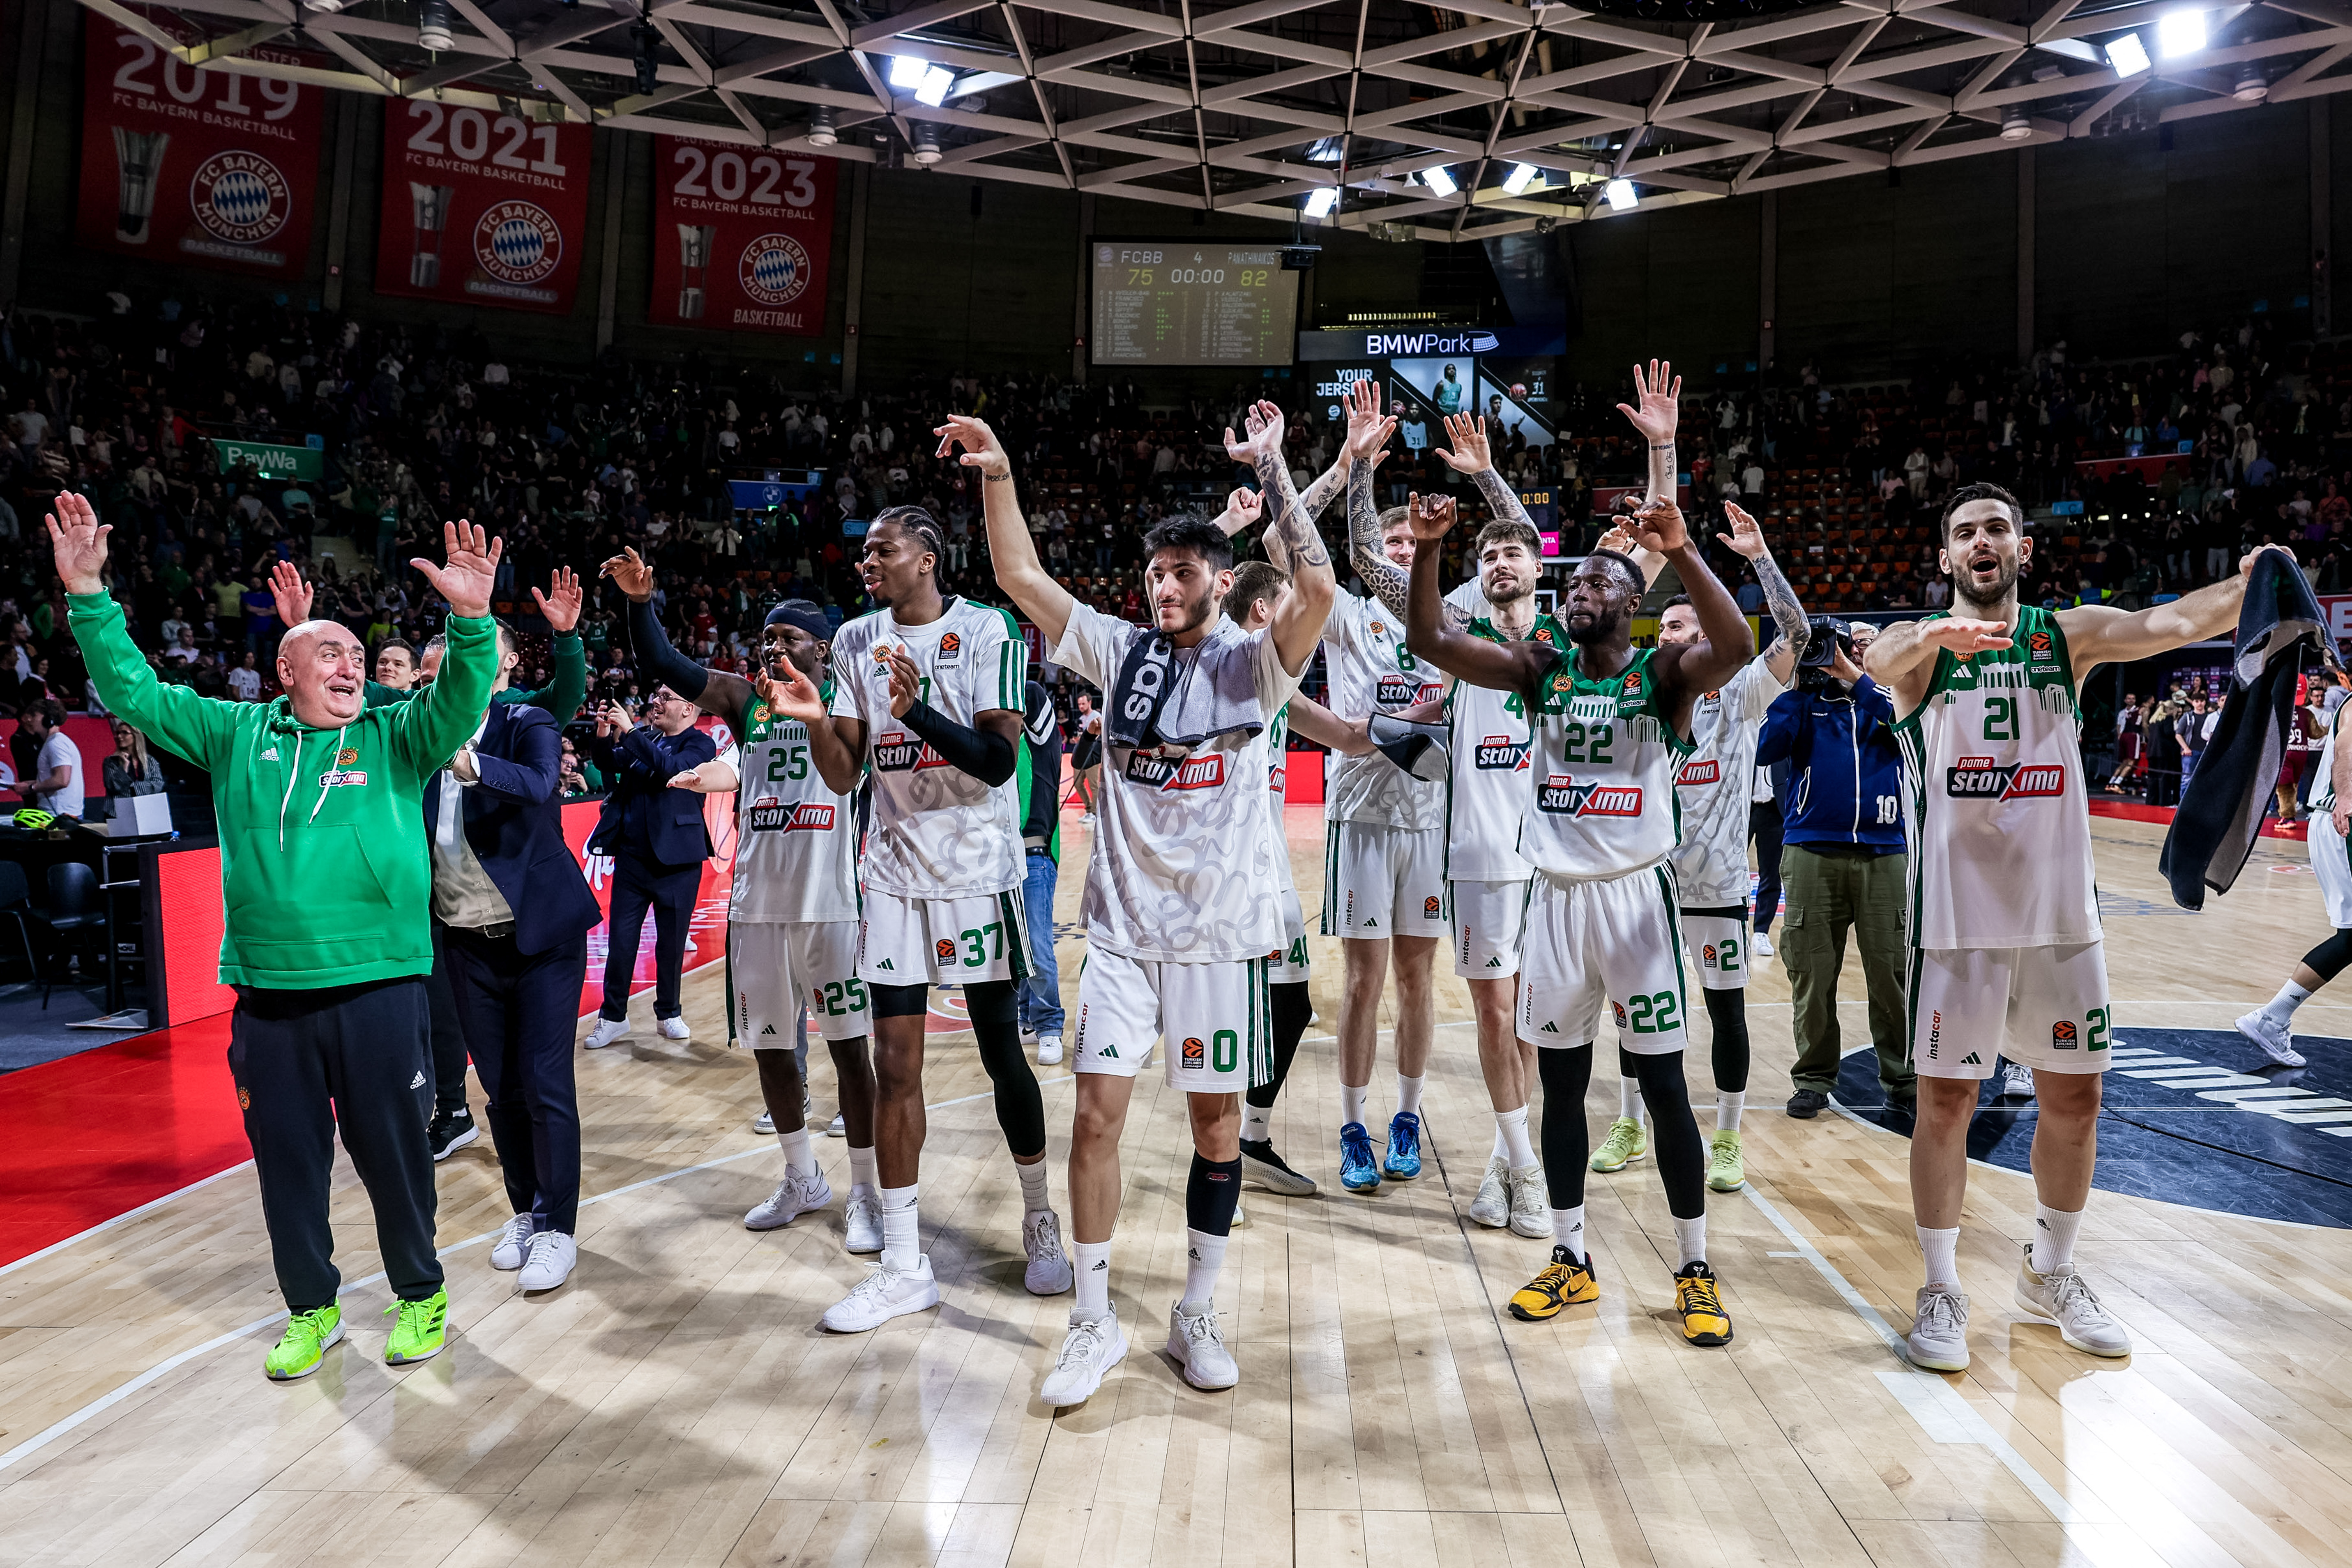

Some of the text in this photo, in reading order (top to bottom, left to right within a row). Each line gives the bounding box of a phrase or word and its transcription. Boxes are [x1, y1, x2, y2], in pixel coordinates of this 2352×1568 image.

[113, 34, 299, 121] 2019
[113, 93, 296, 141] FC BAYERN BASKETBALL
[407, 99, 566, 177] 2021
[198, 155, 285, 198] FC BAYERN
[405, 152, 566, 191] FC BAYERN BASKETBALL
[674, 146, 816, 207] 2023
[673, 197, 815, 221] FC BAYERN BASKETBALL
[481, 205, 557, 243] FC BAYERN
[744, 237, 806, 267] FC BAYERN
[1121, 251, 1163, 264] FCBB
[1193, 252, 1202, 264] 4
[1127, 269, 1153, 286] 75
[1171, 269, 1225, 284] 00:00
[1240, 270, 1267, 286] 82
[733, 309, 803, 328] BASKETBALL
[1075, 338, 1083, 346] A
[1336, 368, 1373, 382] YOUR
[1412, 436, 1420, 445] 31
[228, 446, 297, 470] BayWa
[1396, 642, 1416, 671] 8
[1503, 692, 1524, 719] 4
[1983, 697, 2020, 741] 21
[881, 733, 902, 744] pame
[1484, 737, 1508, 746] pame
[1564, 723, 1613, 764] 22
[767, 746, 808, 782] 25
[1960, 758, 1990, 768] pame
[1548, 776, 1569, 787] pame
[756, 798, 775, 807] pame
[1876, 795, 1897, 824] 10
[961, 921, 1003, 968] 37
[1462, 924, 1471, 965] instacar
[1719, 939, 1740, 971] 2
[824, 977, 868, 1016] 25
[1525, 982, 1533, 1026] instacar
[1629, 990, 1680, 1033] 22
[1077, 1002, 1089, 1054] instacar
[1927, 1010, 1942, 1060] instacar
[1213, 1029, 1238, 1073] 0
[410, 1078, 426, 1089] adidas
